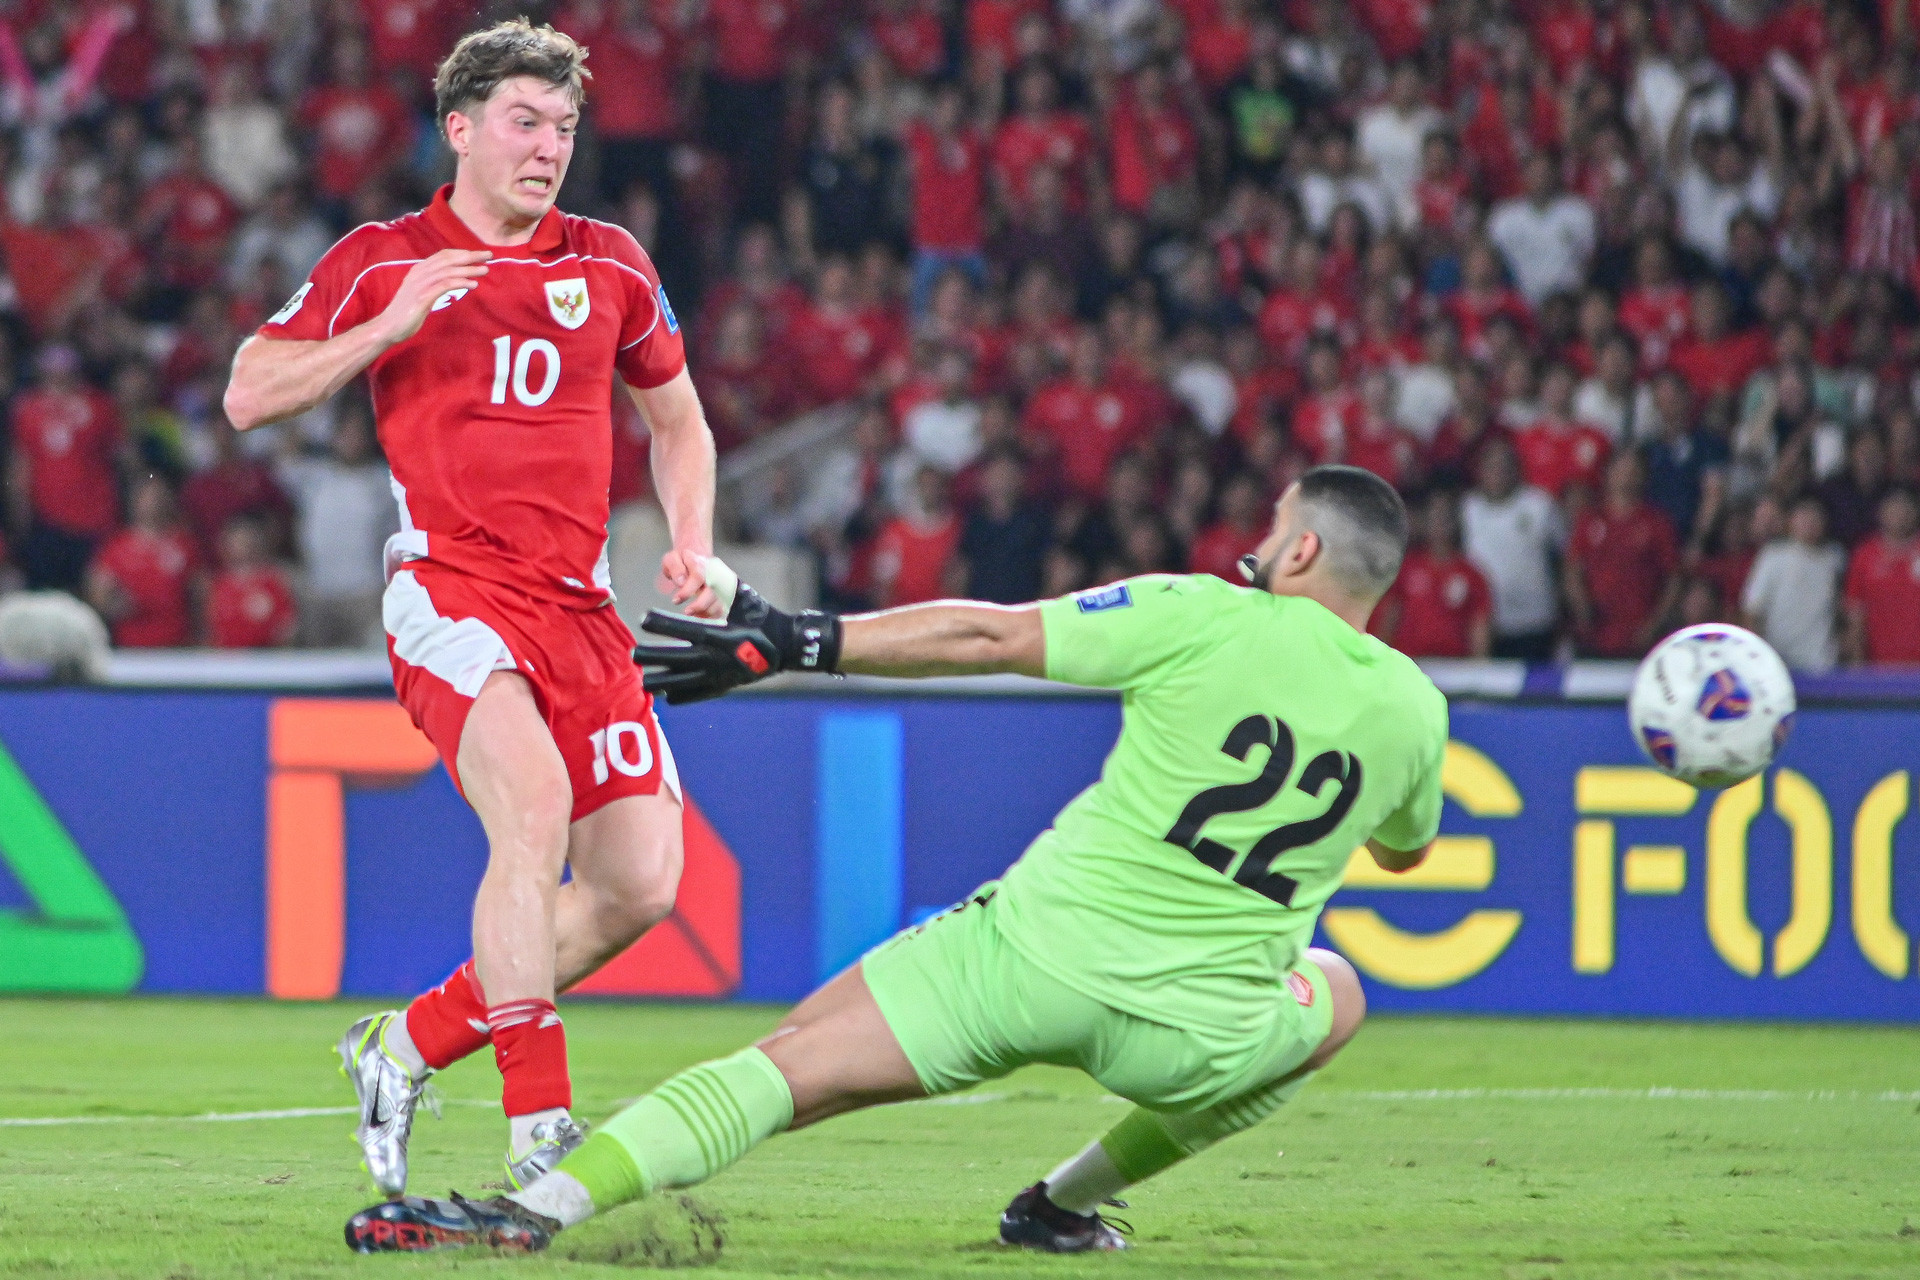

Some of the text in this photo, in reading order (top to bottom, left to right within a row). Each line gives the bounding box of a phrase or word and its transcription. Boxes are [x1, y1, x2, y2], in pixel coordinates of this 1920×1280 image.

[491, 334, 562, 407] 10
[588, 721, 655, 786] 10
[1163, 713, 1364, 909] 22
